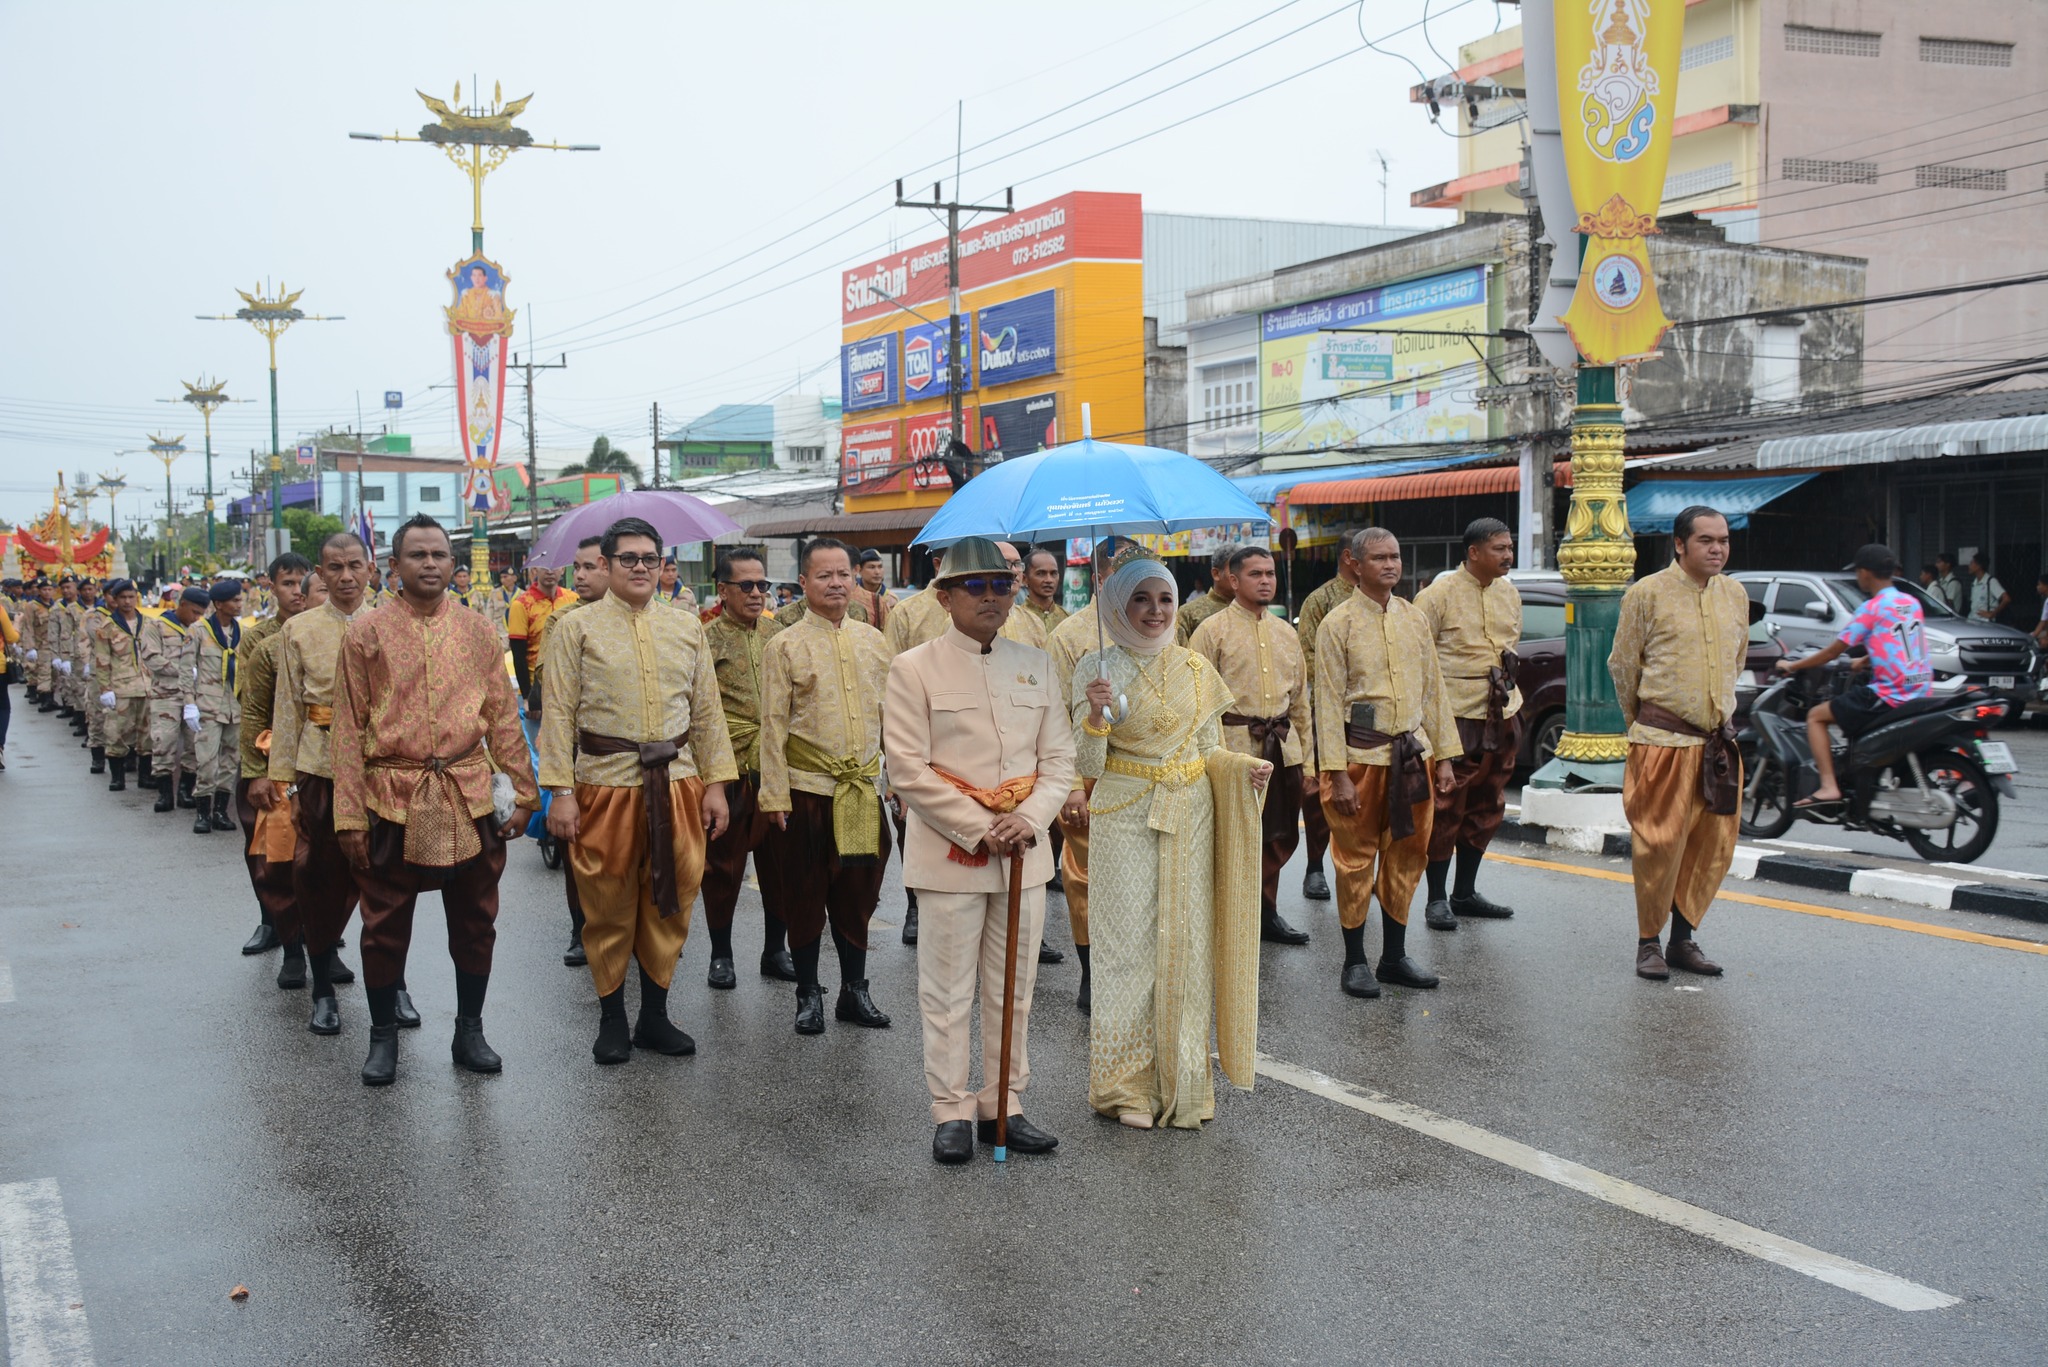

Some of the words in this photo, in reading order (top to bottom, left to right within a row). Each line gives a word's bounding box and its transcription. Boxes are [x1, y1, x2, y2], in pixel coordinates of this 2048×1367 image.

[1267, 302, 1332, 332] ร้านเพื่อนสัตว์
[1337, 300, 1365, 320] สาขา
[1367, 297, 1374, 313] 1
[907, 351, 929, 375] TOA
[981, 347, 1015, 371] Dulux
[1890, 619, 1926, 667] 11
